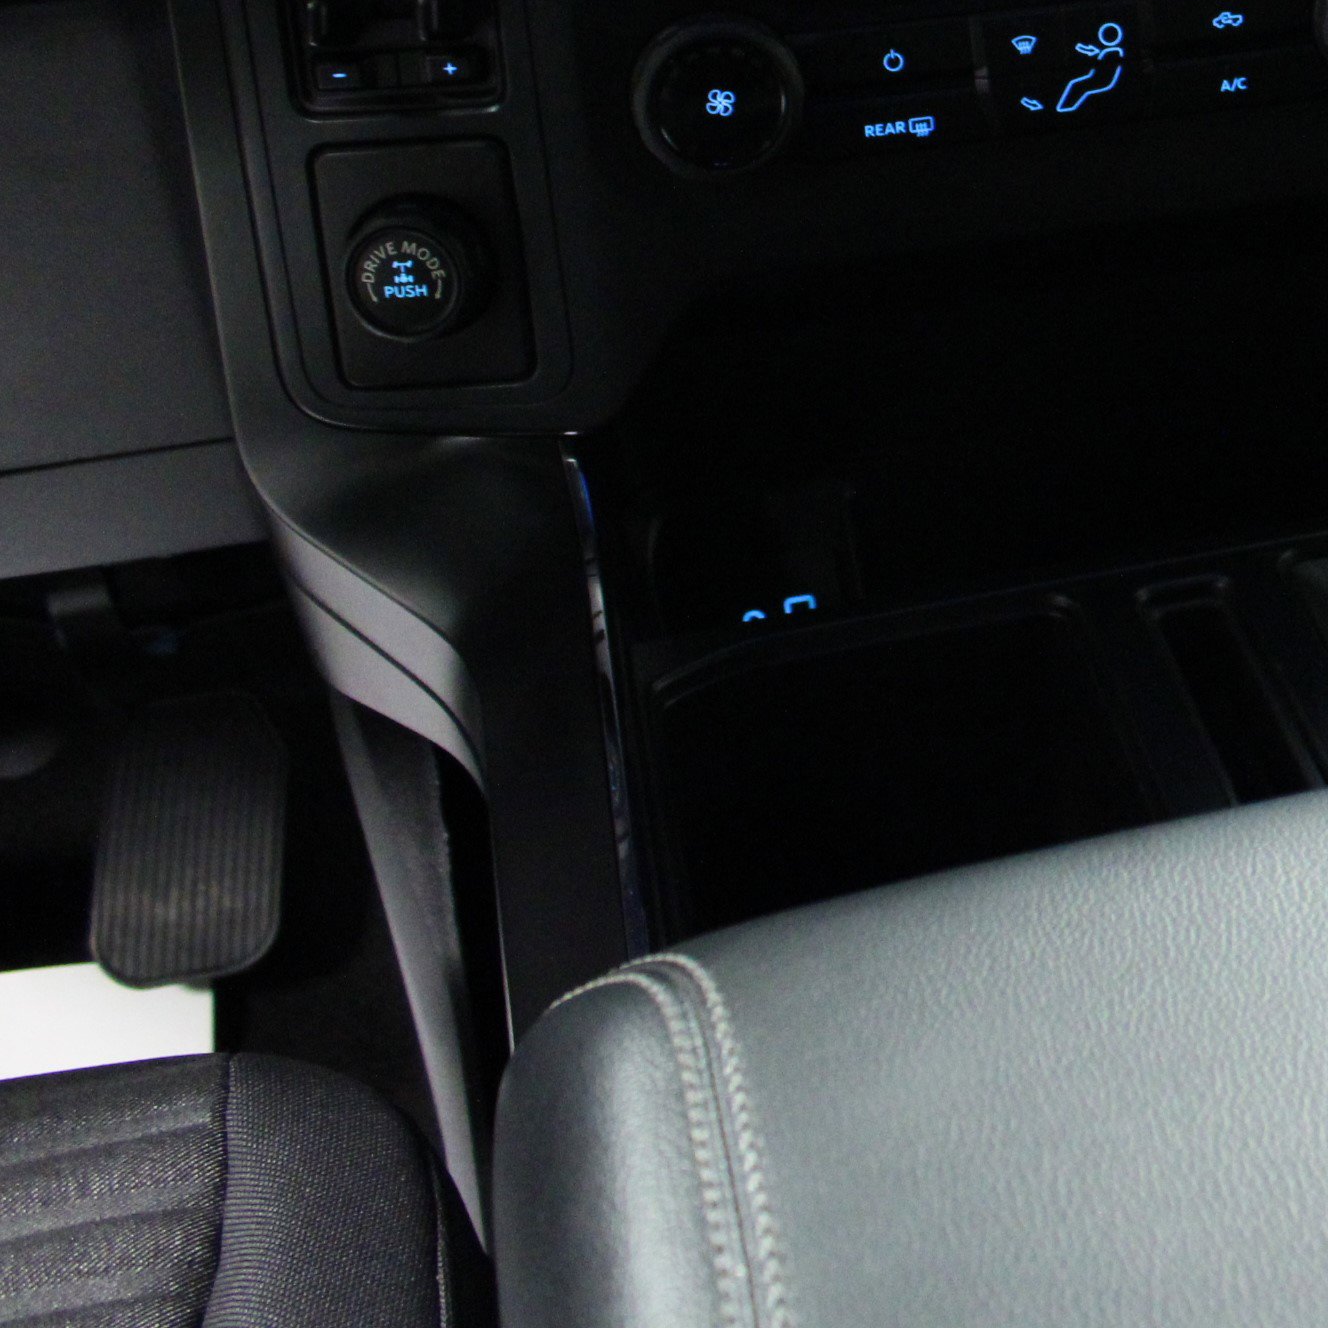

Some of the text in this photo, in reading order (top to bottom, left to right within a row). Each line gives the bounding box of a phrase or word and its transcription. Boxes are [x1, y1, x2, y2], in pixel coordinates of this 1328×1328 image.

[1220, 77, 1249, 93] A/C
[864, 120, 907, 139] REAR
[361, 240, 446, 283] DRIVE MODE
[384, 284, 429, 299] PUSH
